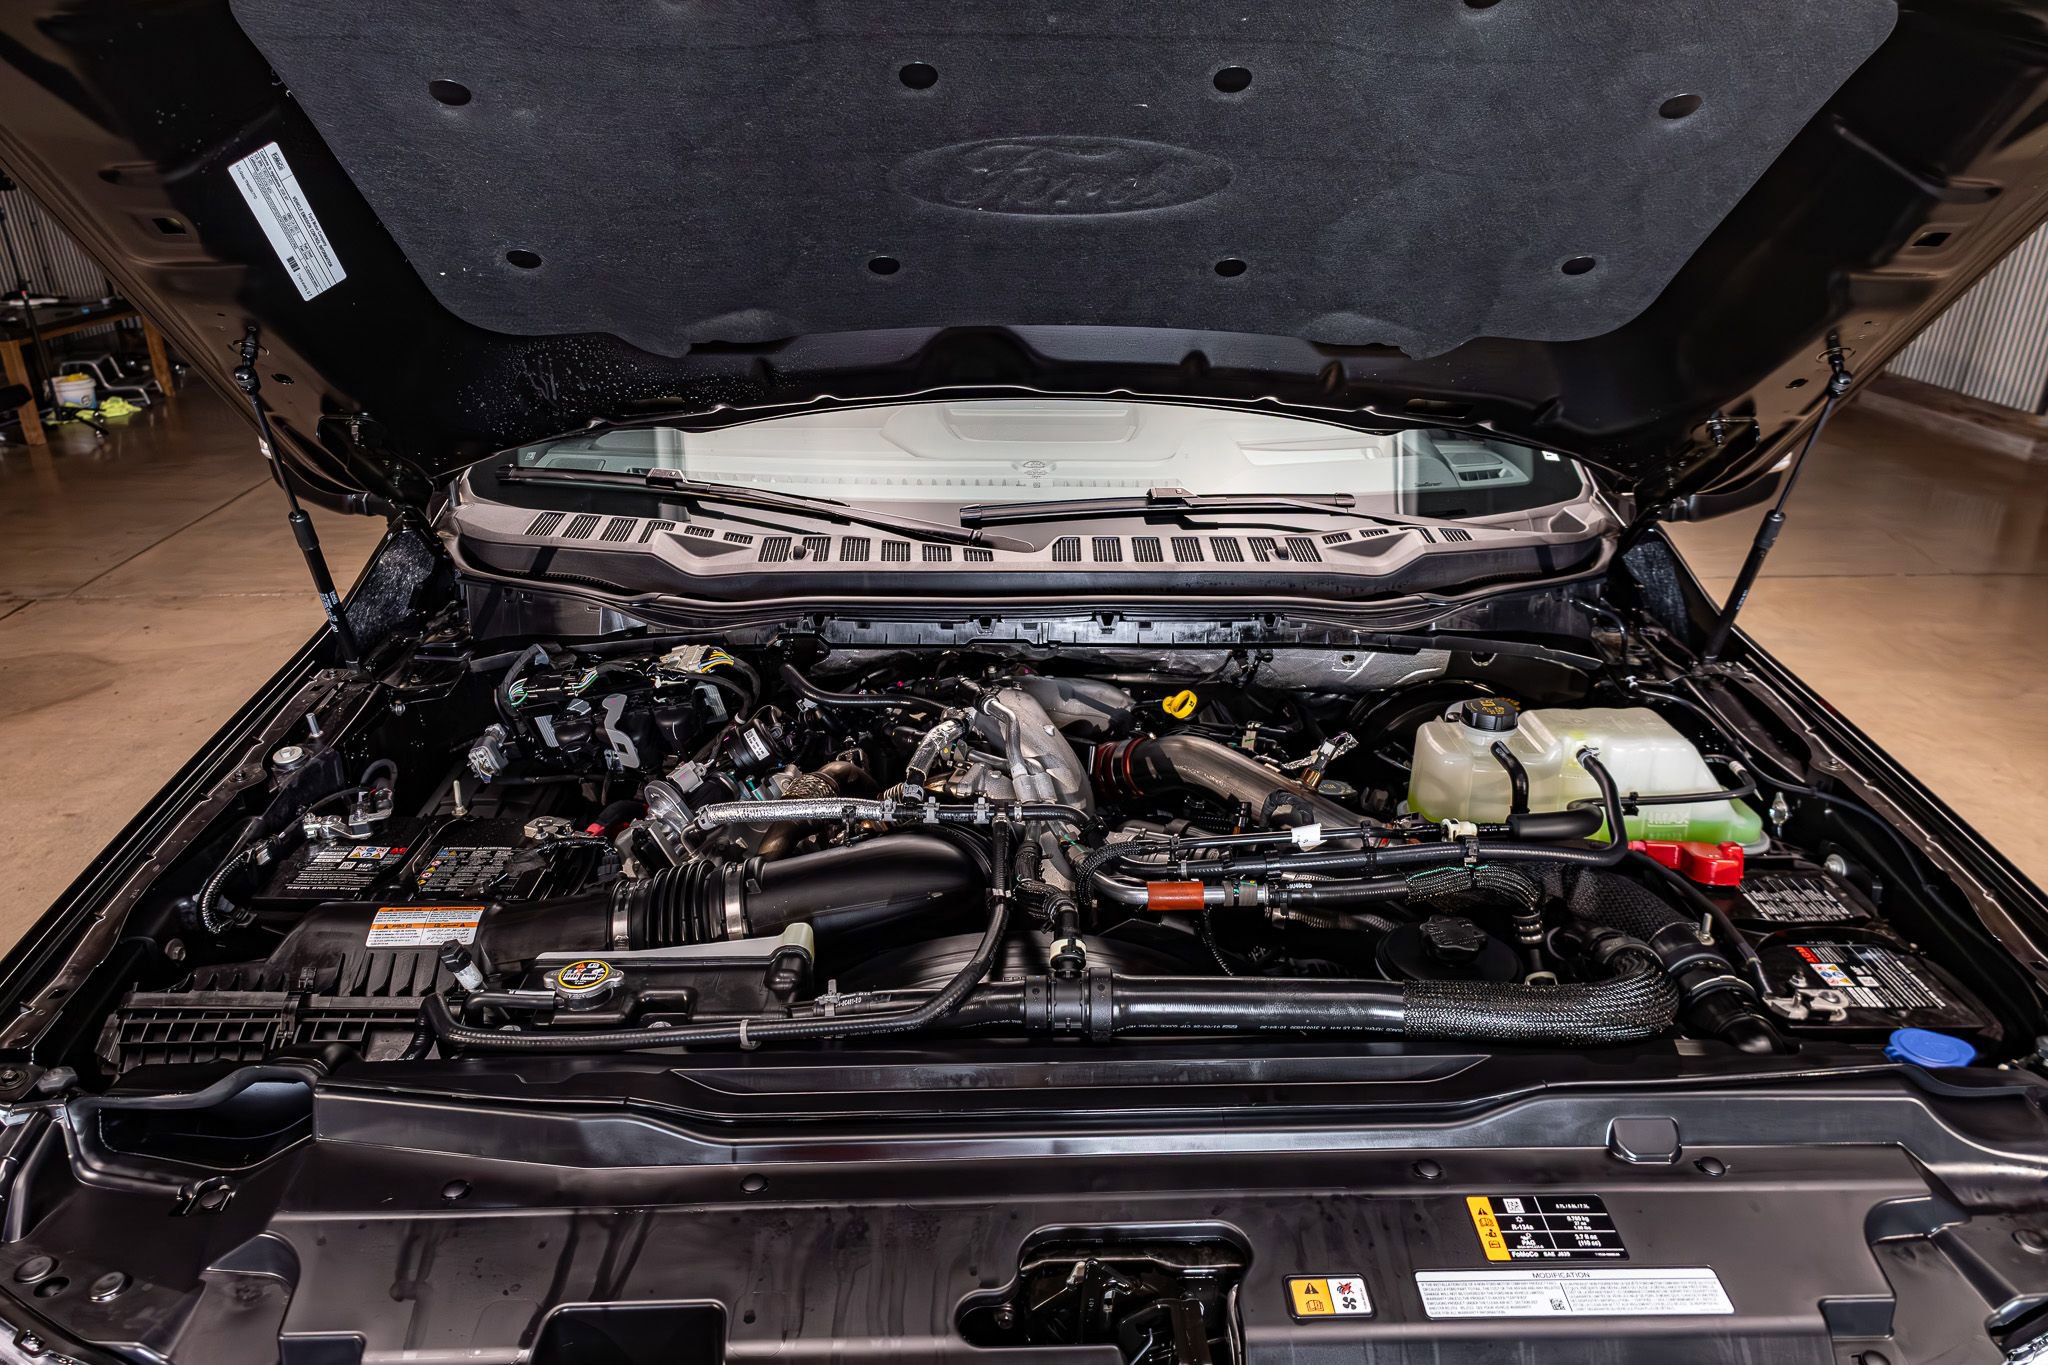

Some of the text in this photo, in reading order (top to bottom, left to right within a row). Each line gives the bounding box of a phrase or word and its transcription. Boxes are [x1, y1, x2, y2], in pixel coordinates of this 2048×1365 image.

[944, 144, 1168, 206] Ford
[291, 195, 332, 267] VEHICLE EMISSION CONTROL INFORMATION
[311, 220, 319, 231] Motor
[316, 230, 327, 246] Company
[1531, 1271, 1591, 1279] MODIFICATION
